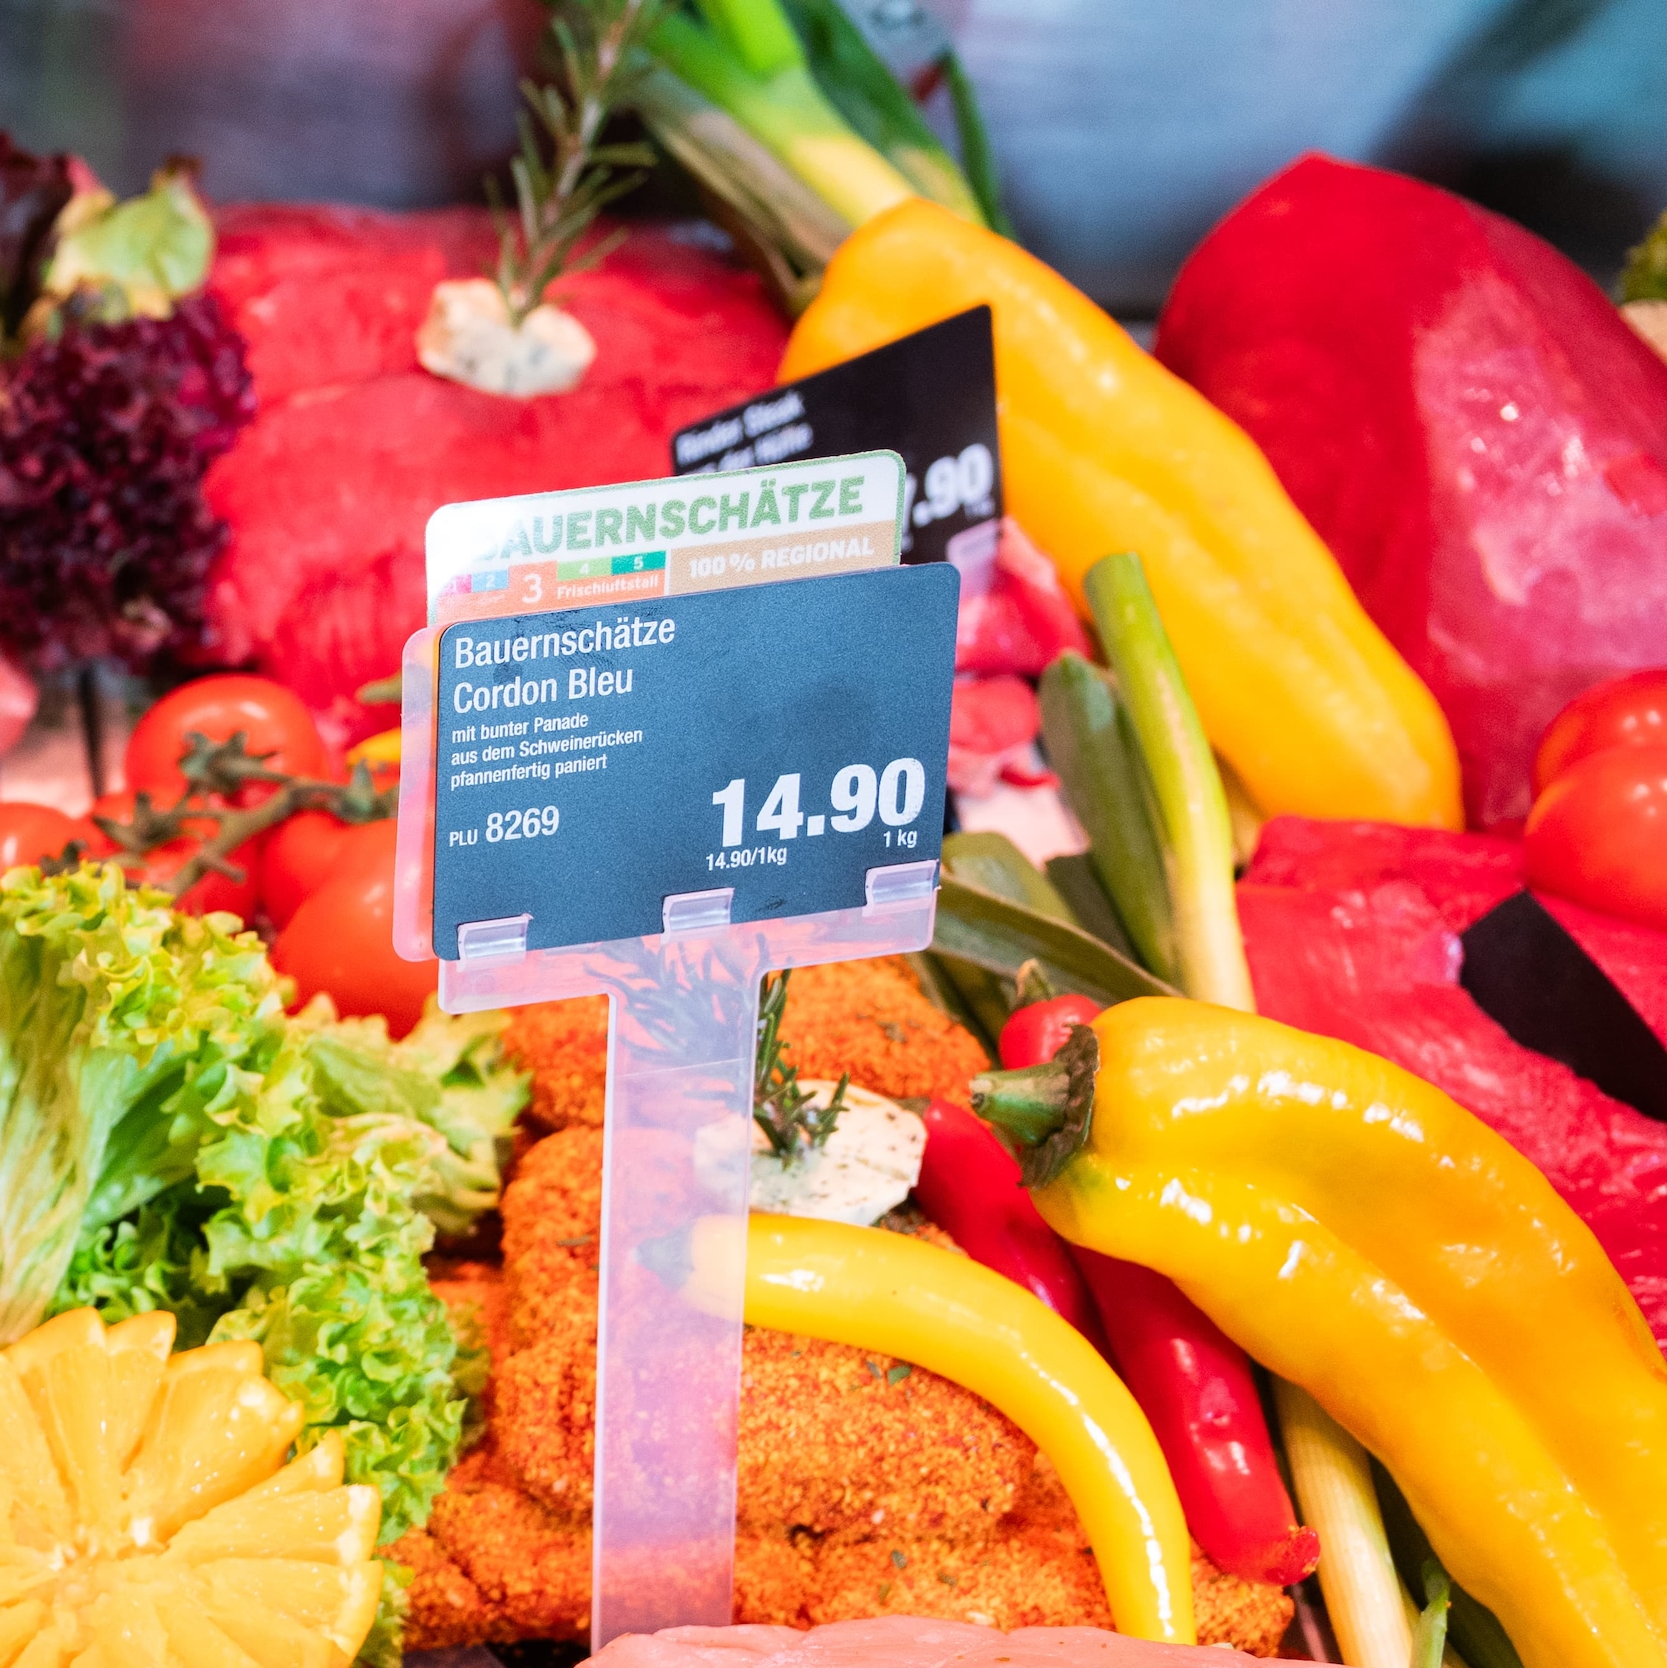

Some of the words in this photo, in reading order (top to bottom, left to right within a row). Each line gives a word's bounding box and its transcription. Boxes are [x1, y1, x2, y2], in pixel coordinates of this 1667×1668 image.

[689, 554, 725, 578] 100
[727, 550, 757, 572] %
[760, 537, 874, 570] REGIONAL
[522, 573, 543, 604] 3
[633, 556, 645, 570] 5
[557, 574, 659, 600] Frischluftstall
[455, 617, 675, 670] Bauernschätze
[453, 676, 558, 714] Cordon
[568, 666, 634, 701] Bleu
[451, 747, 479, 766] aus
[482, 741, 516, 763] dem
[519, 726, 644, 760] Schweinerücken
[452, 724, 477, 743] mit
[480, 717, 530, 739] bunter
[534, 711, 589, 734] Panade
[450, 761, 552, 792] pfannenfertig
[554, 753, 609, 784] paniert
[712, 757, 926, 848] 14.90
[449, 827, 478, 848] PLU
[485, 805, 560, 844] 8269
[883, 831, 893, 848] 1
[896, 828, 919, 850] kg
[705, 845, 789, 872] 14.90/1kg
